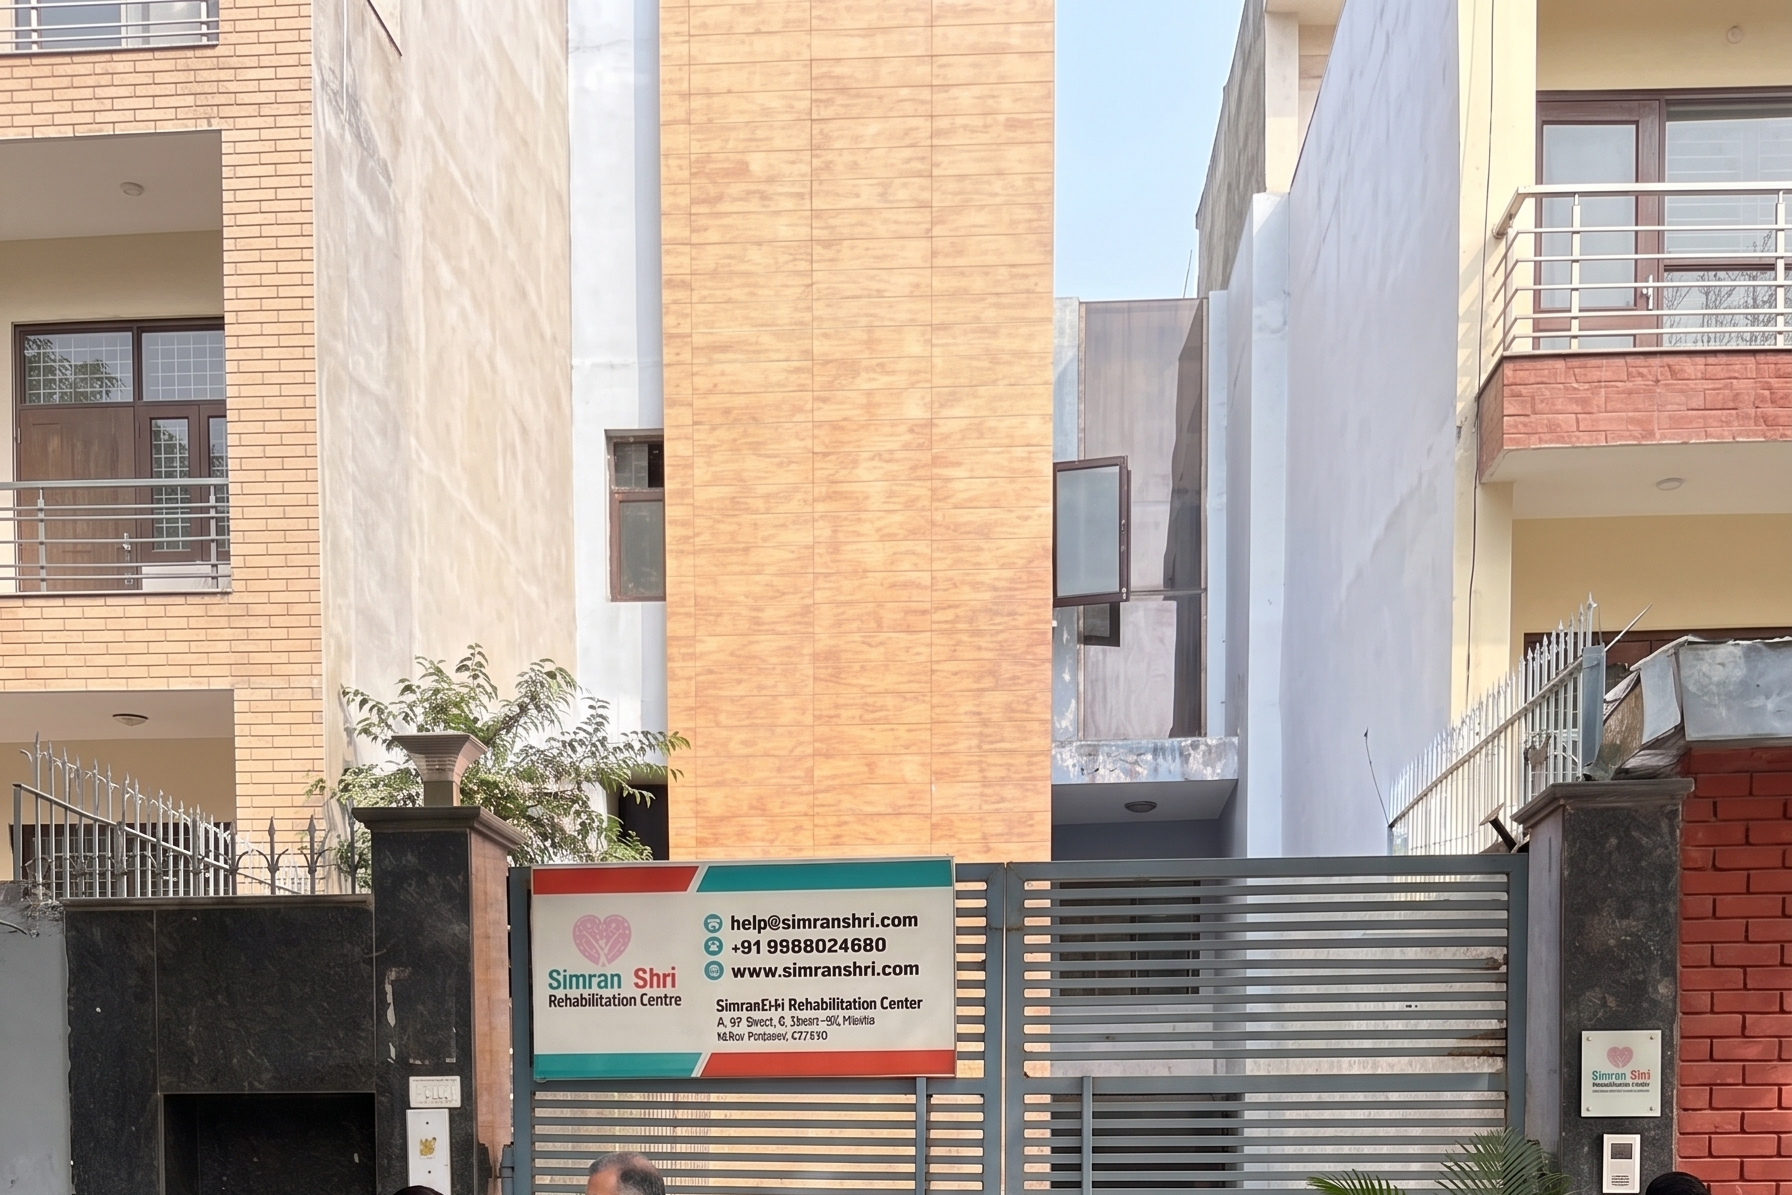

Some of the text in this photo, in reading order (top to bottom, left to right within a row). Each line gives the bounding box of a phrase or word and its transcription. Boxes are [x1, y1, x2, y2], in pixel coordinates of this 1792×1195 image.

[730, 912, 919, 934] help@simranshri.com
[731, 937, 887, 954] +91 9988024680
[548, 966, 676, 990] Simran Shri
[731, 961, 920, 978] www.simranshri.com
[548, 993, 682, 1008] Rehabilitation Centre
[788, 997, 877, 1012] Rehabilitation
[880, 995, 923, 1010] Center
